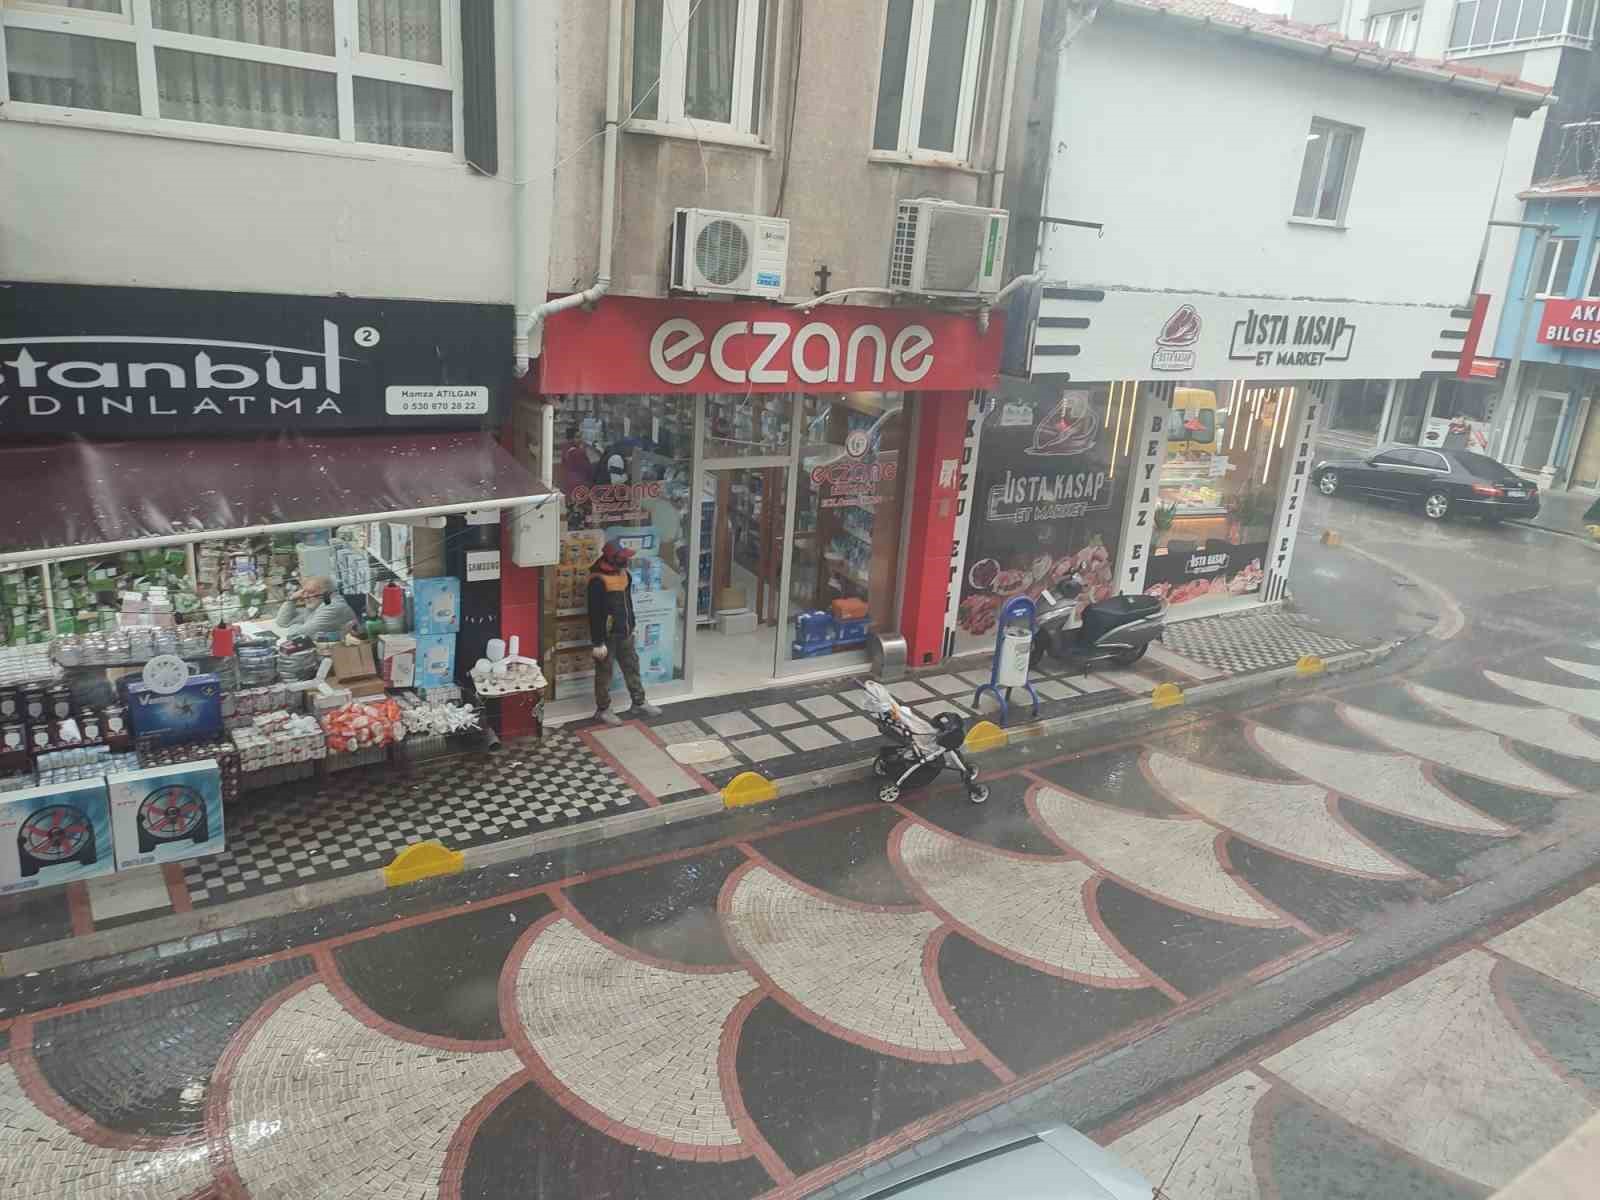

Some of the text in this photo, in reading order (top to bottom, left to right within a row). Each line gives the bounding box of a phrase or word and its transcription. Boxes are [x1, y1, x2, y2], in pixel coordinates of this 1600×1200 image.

[363, 330, 372, 341] 2
[1293, 315, 1346, 351] KASAP
[0, 318, 340, 394] tanbul
[651, 317, 934, 386] eczane
[1256, 351, 1326, 366] ET MARKET
[402, 390, 477, 398] Hamza ATILGAN
[403, 402, 409, 411] 0
[464, 402, 477, 411] 22
[956, 419, 975, 516] KUZU
[1055, 471, 1105, 502] KASAP
[1129, 416, 1162, 582] BEYAZ ET
[468, 560, 499, 573] SAMSUNG
